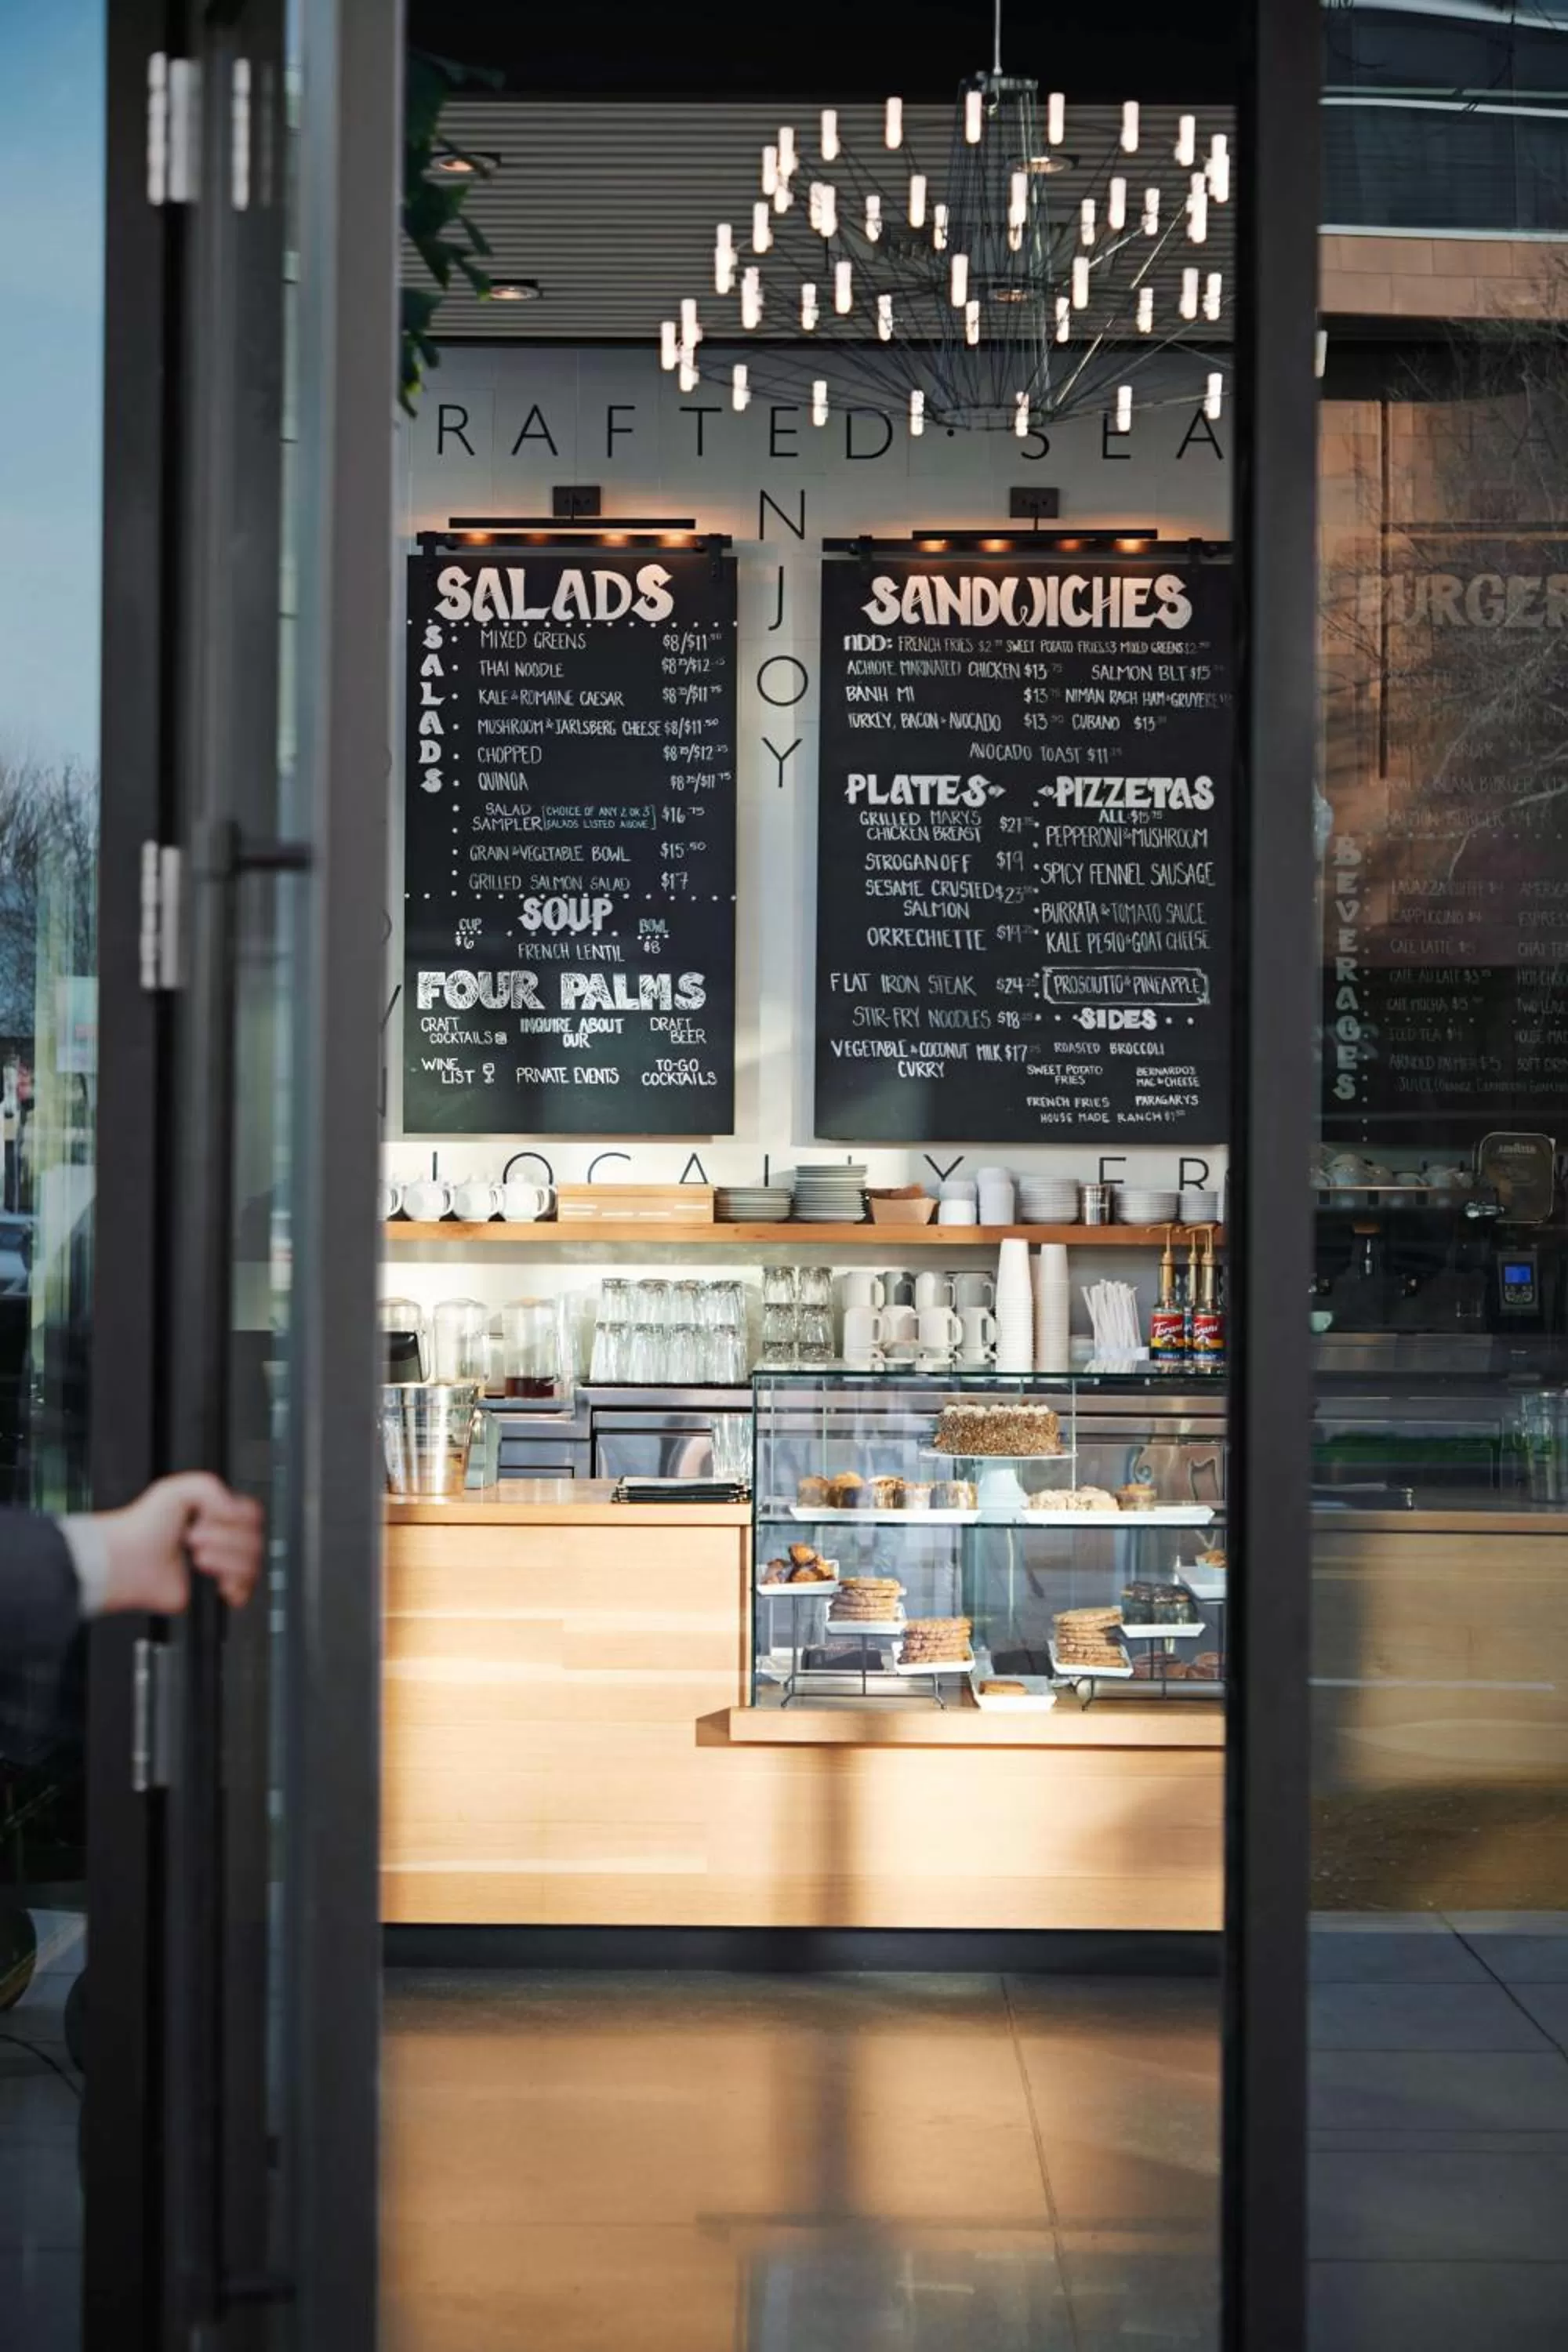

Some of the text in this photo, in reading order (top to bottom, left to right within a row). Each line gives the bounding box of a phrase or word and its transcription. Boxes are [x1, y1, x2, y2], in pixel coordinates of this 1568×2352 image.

[434, 563, 674, 622] SALADS
[862, 574, 1193, 629] SANDWICHES
[480, 630, 587, 650] MIXED GREENS
[898, 636, 941, 652] FRENCH
[479, 660, 564, 678] THAI NOODLE
[967, 662, 1020, 680] CHICKEN
[1091, 665, 1153, 681] SALMON
[1158, 665, 1185, 681] BLT
[478, 689, 625, 706] KALE ROMAINE CAESAR
[846, 686, 889, 702] BANH
[897, 686, 915, 702] MI
[1065, 687, 1105, 704] NIMAN
[1142, 691, 1166, 706] HAM
[418, 625, 445, 793] SALADS
[477, 719, 662, 736] MUSHROOM JARLSBERG CHEESE
[901, 712, 940, 730] BACON
[1072, 713, 1120, 731] CUBANO
[477, 746, 543, 764] CHOPPED
[969, 742, 1082, 764] AVOCADO TOAST
[477, 771, 529, 792] QUINOA
[844, 773, 1215, 811] PLATES PIZZETAS
[485, 802, 532, 816] SALAD
[859, 810, 921, 826] GRILLED
[1099, 808, 1127, 823] ALL
[472, 816, 543, 831] SAMPLER
[866, 826, 982, 843] CHICKEN BREAST
[1046, 826, 1208, 849] PEPPERONI MUSHROOM
[470, 844, 509, 862] GRAIN
[520, 846, 585, 862] VEGETABLE
[592, 846, 632, 862] BOWL
[865, 850, 1024, 873] STROGANOFF $19
[469, 871, 688, 891] GRILLED SALMON SALAD $17
[1041, 862, 1216, 887] SPICY FENNEL SAUSAGE
[866, 879, 994, 899] SESAME CRUSTED
[517, 897, 614, 932] SOUP
[903, 899, 971, 920] SALMON
[1041, 901, 1207, 925] BURRATA TOMATO SAUCE
[458, 918, 482, 931] CUP
[639, 918, 669, 934] BOWL
[1045, 930, 1213, 954] KALE PESTO GOAT CHEESE
[517, 942, 626, 962] FRENCH LENTIL
[1333, 836, 1363, 1100] BEVERAGES
[416, 969, 707, 1011] FOUR PALMS
[830, 972, 977, 996] FLAT IRON STEAK
[1053, 975, 1201, 996] PROSCIUTTO PINEAPPLE
[420, 1017, 693, 1034] CRAFT INQUIRE ABOUT DRAFT
[852, 1006, 992, 1029] STIR-FRY NOODLES
[1077, 1007, 1157, 1030] SIDES
[430, 1031, 493, 1045] COCKTAILS
[562, 1033, 591, 1048] OUR
[670, 1029, 707, 1044] BEER
[830, 1039, 909, 1058] VEGETABLE
[976, 1044, 1004, 1062] MILK
[1054, 1042, 1165, 1055] ROASTED BROCCOLI
[421, 1058, 459, 1071] WINE
[655, 1058, 699, 1072] TO-GO
[898, 1061, 946, 1079] CURRY
[1026, 1064, 1104, 1076] SWEET POTATO
[441, 1069, 475, 1084] LIST
[515, 1067, 620, 1084] PRIVATE EVENTS
[641, 1071, 718, 1086] COCKTAILS
[1054, 1075, 1086, 1085] FRIES
[1078, 1112, 1111, 1123] MADE
